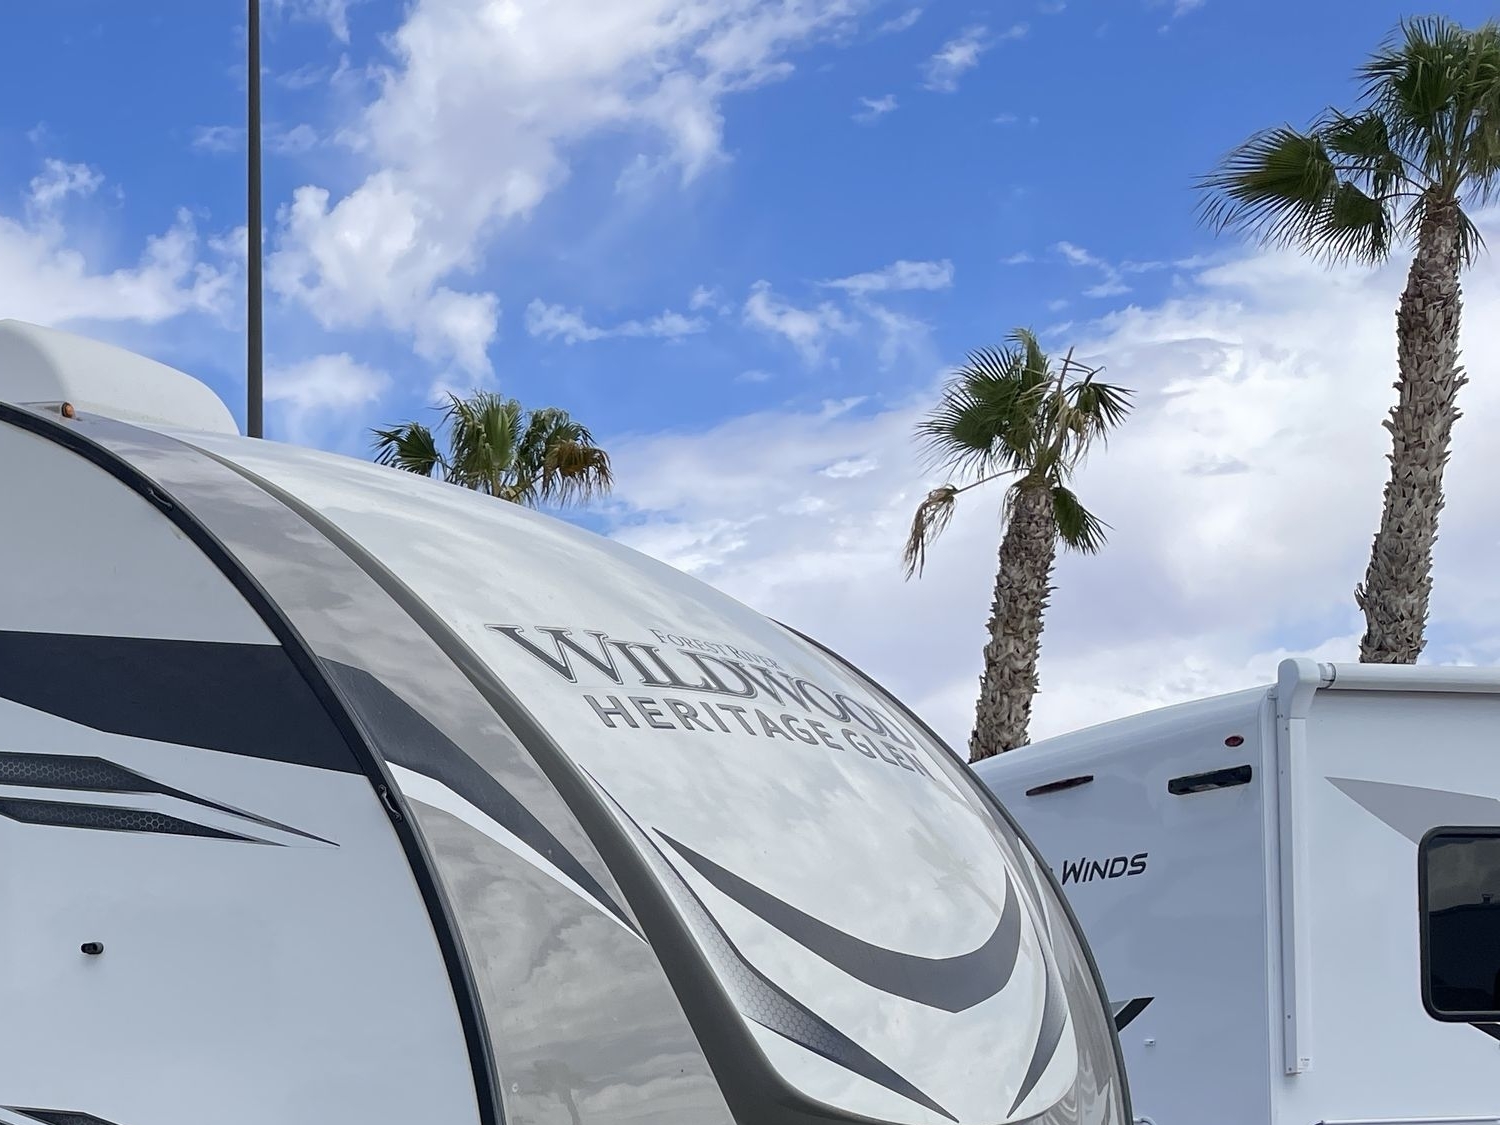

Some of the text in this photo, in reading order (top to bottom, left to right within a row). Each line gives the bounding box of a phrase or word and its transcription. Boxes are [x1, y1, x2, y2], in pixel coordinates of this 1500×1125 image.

[649, 628, 727, 656] FOREST
[484, 623, 917, 751] WILDWOOD
[582, 694, 937, 782] HERITAGE GLEN
[1061, 852, 1149, 886] WINDS
